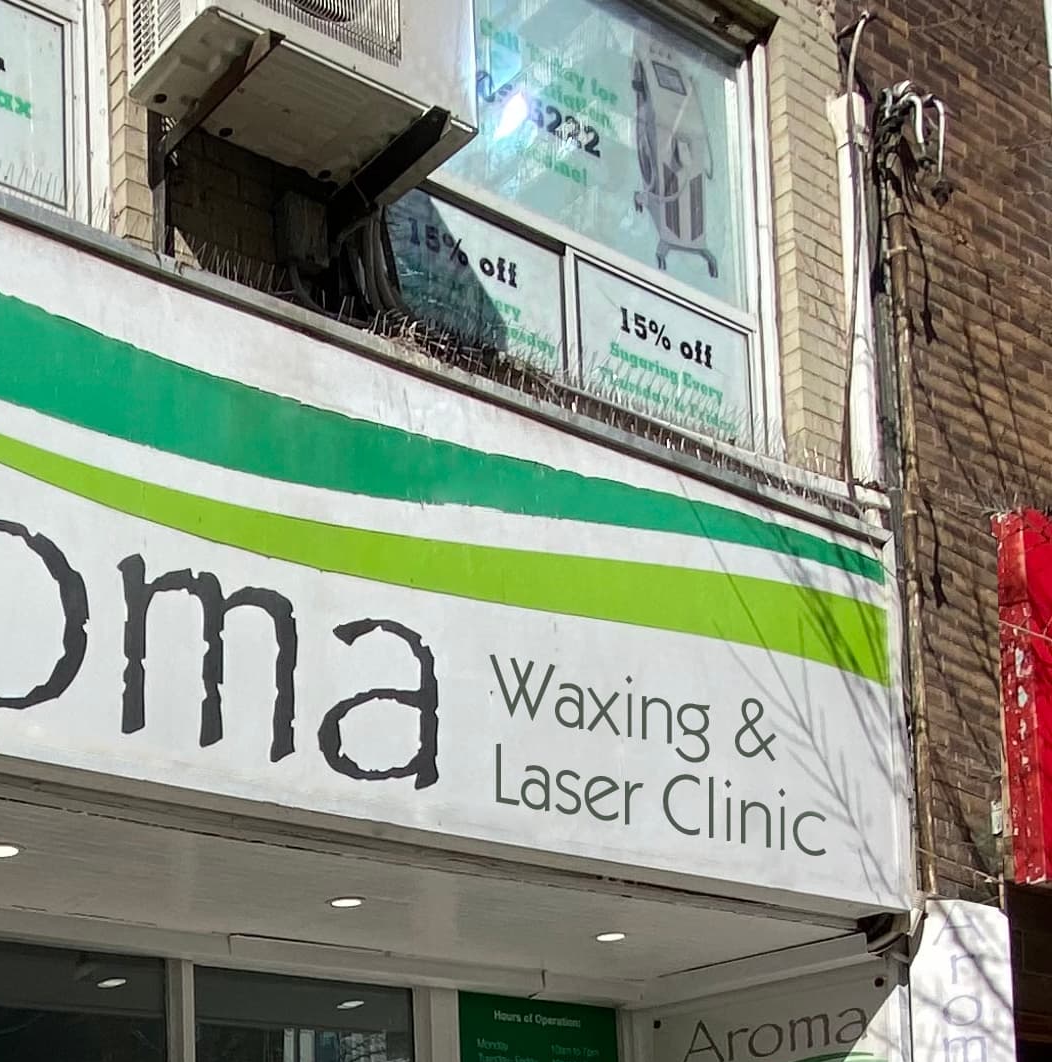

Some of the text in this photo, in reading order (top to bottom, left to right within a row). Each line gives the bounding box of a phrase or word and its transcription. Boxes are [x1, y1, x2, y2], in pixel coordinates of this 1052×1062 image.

[409, 217, 517, 288] 15% off
[610, 341, 679, 385] Sugaring
[621, 307, 712, 369] 15% off
[490, 654, 776, 762] Waxing &
[495, 743, 827, 857] Laser Clinic
[476, 1038, 509, 1052] Monday
[493, 1009, 522, 1023] Hours
[523, 1013, 533, 1023] of
